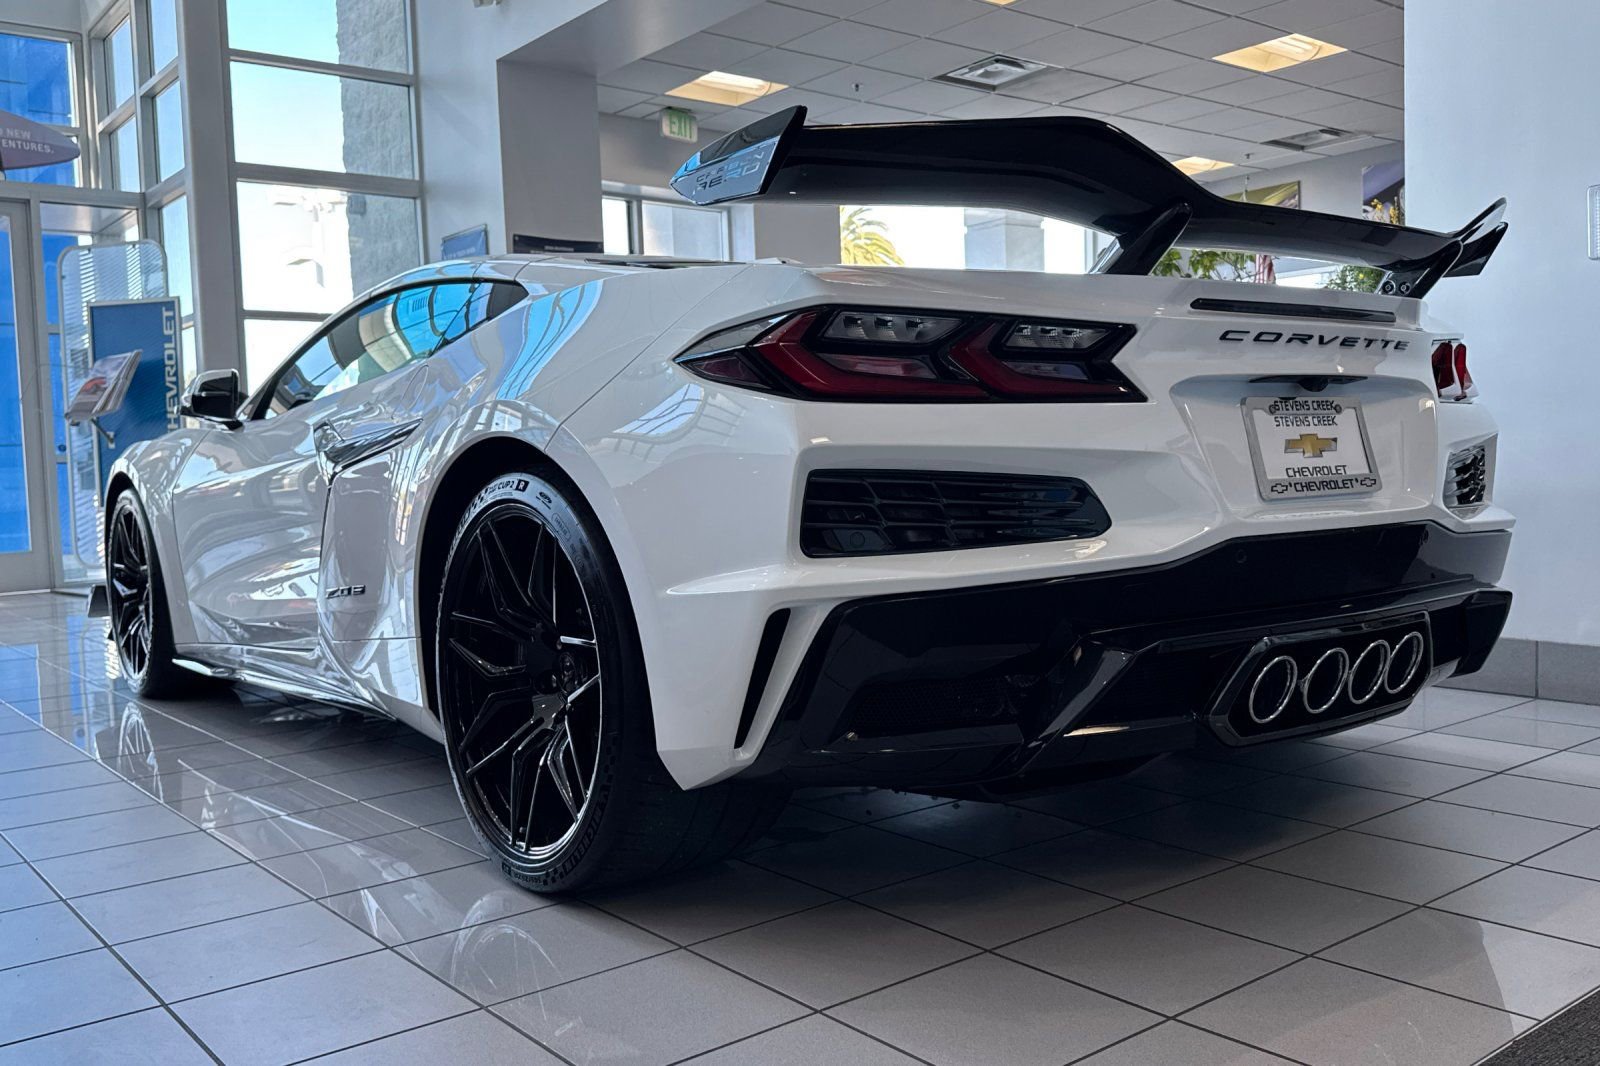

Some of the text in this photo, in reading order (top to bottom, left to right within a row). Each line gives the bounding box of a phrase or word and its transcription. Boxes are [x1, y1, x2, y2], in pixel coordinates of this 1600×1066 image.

[669, 112, 692, 139] EXIT
[6, 127, 31, 140] NEW
[1219, 330, 1410, 351] CORVETTE
[162, 306, 179, 433] HEVROLET
[1274, 400, 1336, 412] STEVENS CREEK
[1274, 415, 1338, 427] STEVENS CREEK
[1285, 465, 1347, 478] CHEVROLET
